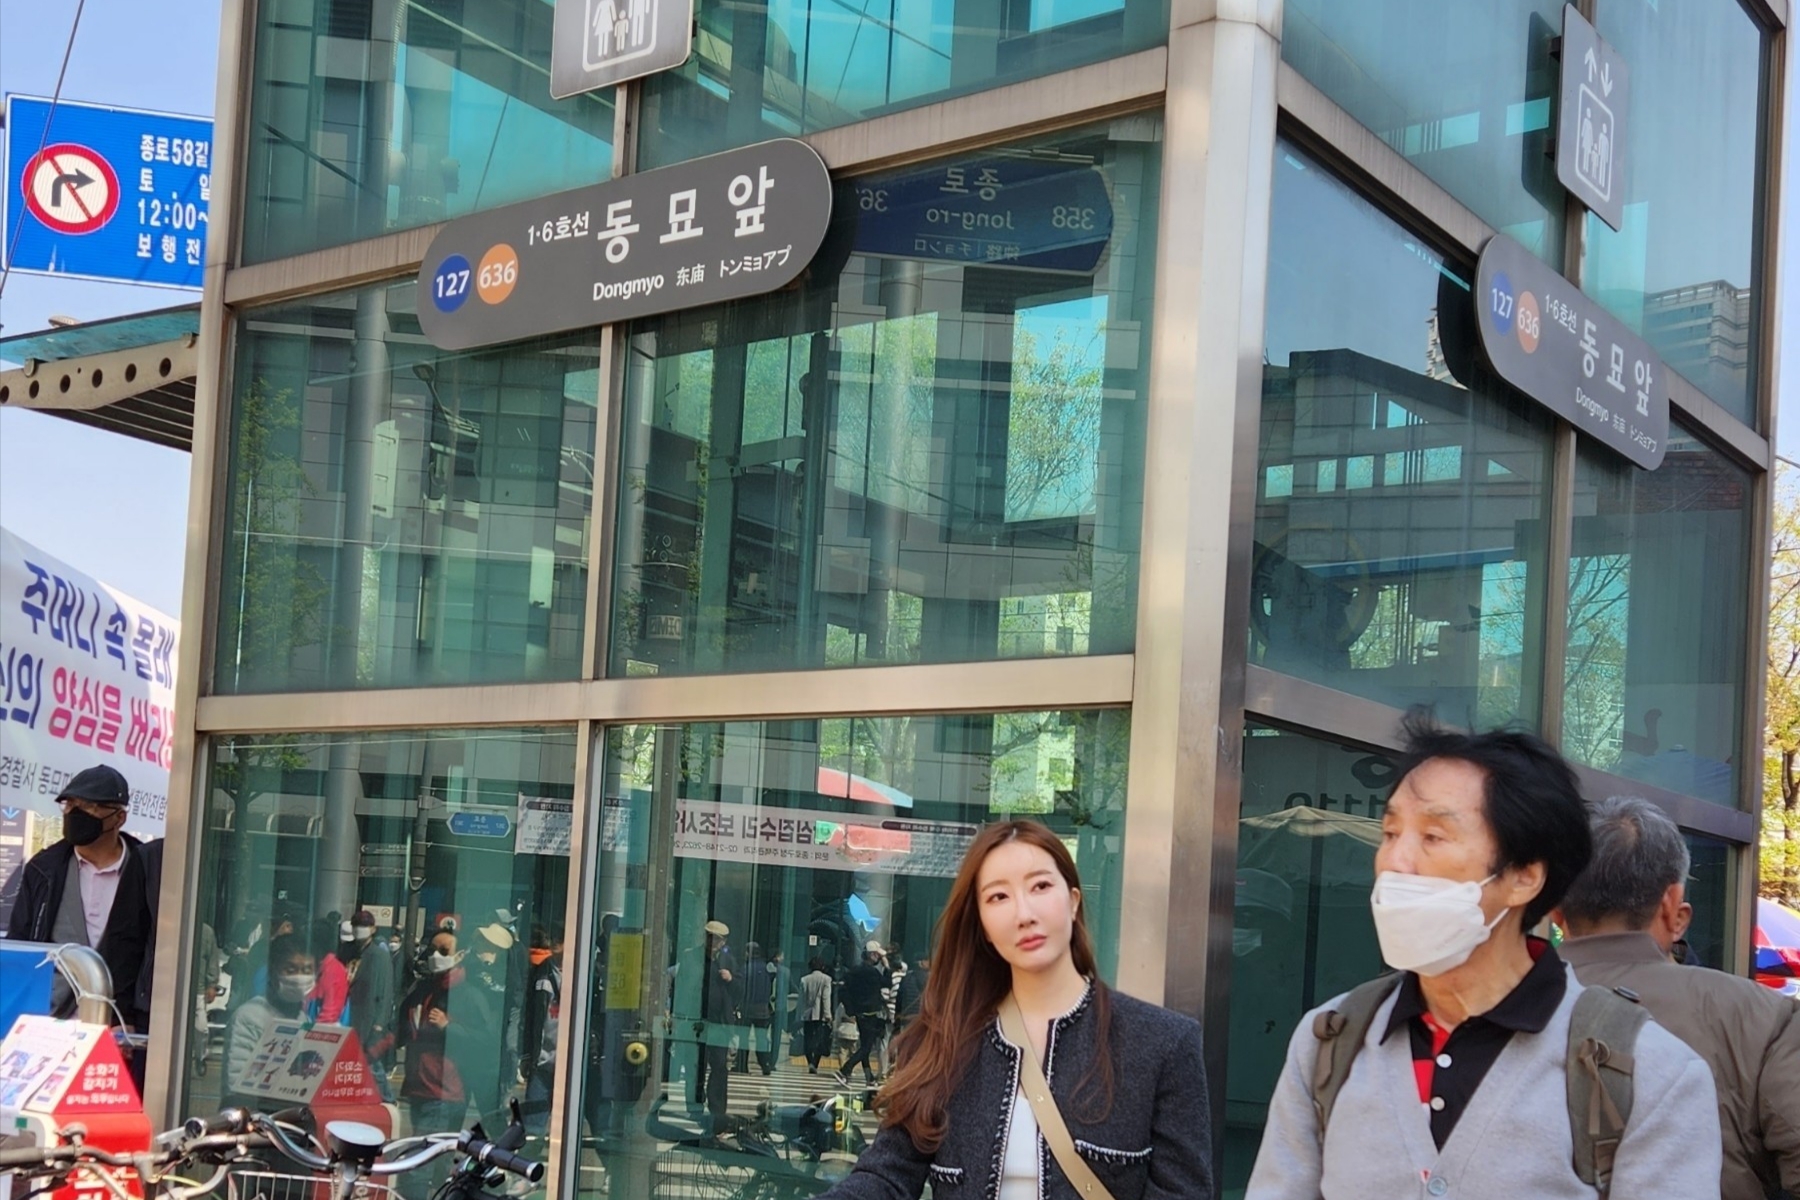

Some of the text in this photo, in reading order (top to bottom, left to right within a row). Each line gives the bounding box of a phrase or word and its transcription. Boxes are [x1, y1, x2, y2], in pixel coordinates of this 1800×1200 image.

[140, 134, 209, 168] 종로58길
[435, 259, 517, 299] 127 636
[592, 272, 665, 302] Dongmyo
[675, 263, 706, 287] 东庙
[1491, 288, 1540, 339] 127 636
[1575, 386, 1610, 422] Dongmyo
[20, 558, 175, 691] 주머니 속 몰래
[47, 665, 123, 755] 양심을
[0, 755, 38, 795] 경찰서
